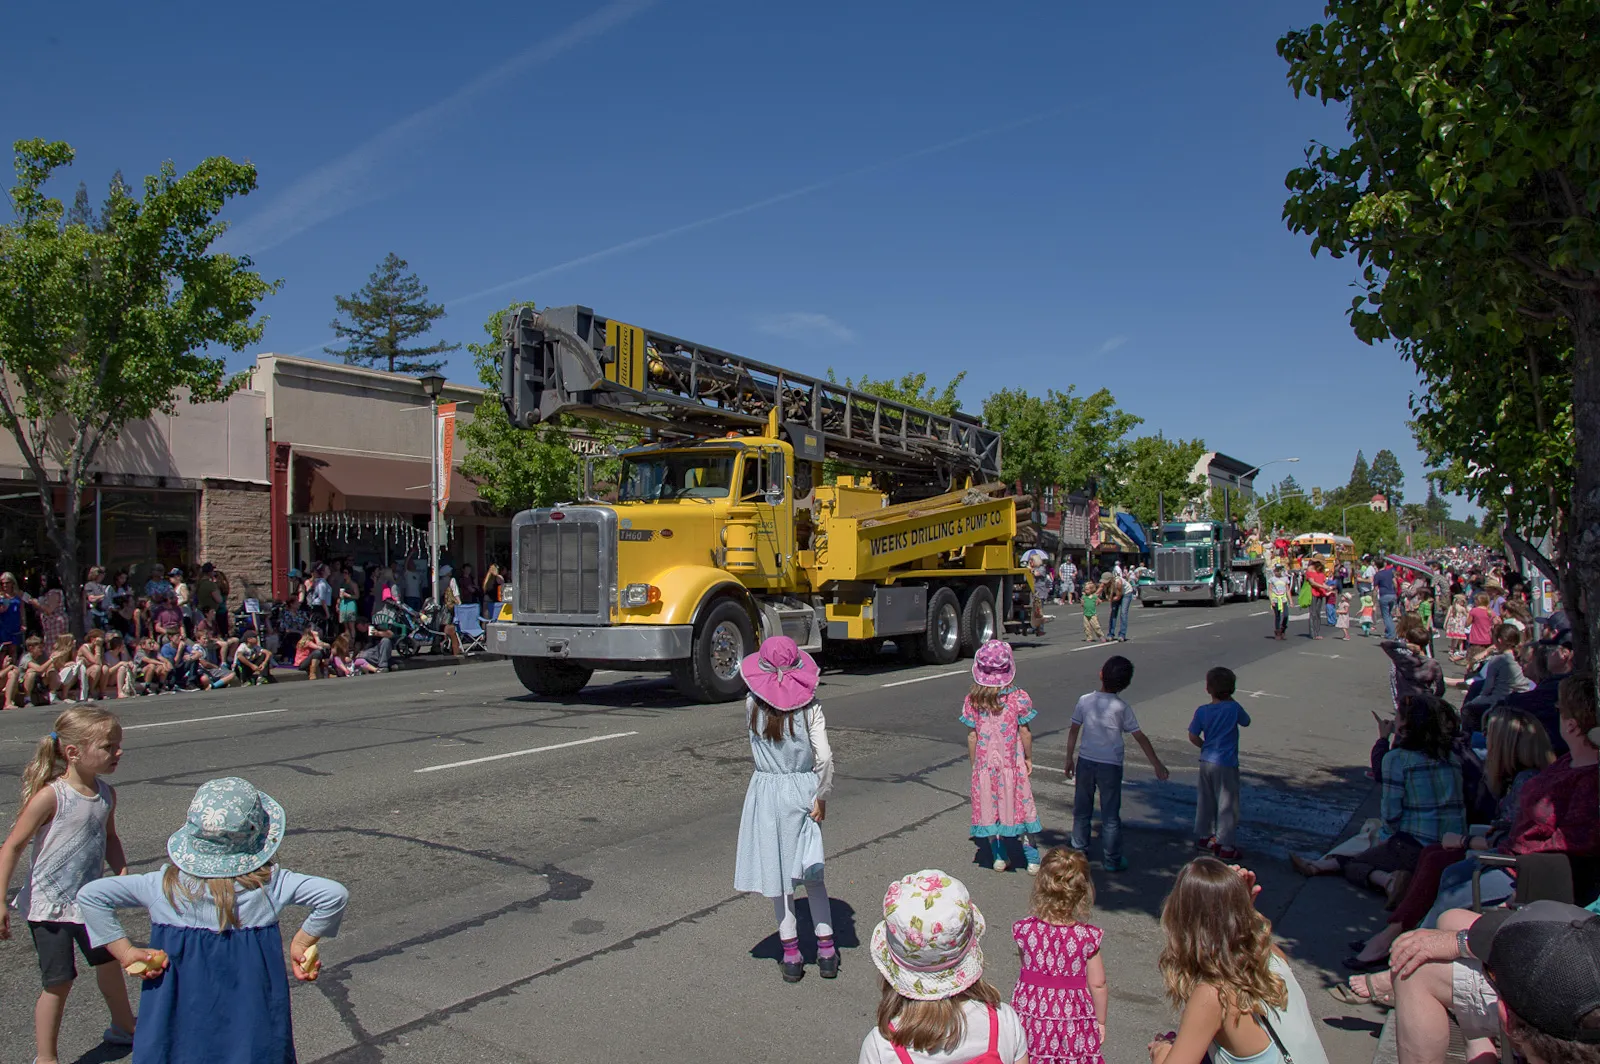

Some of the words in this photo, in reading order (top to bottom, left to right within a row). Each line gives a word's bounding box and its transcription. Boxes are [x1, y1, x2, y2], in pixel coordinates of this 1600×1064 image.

[620, 531, 642, 540] TH60
[870, 531, 908, 556] WEEKS
[911, 520, 955, 546] DRILLING
[957, 519, 963, 534] &
[965, 513, 988, 532] PUMP
